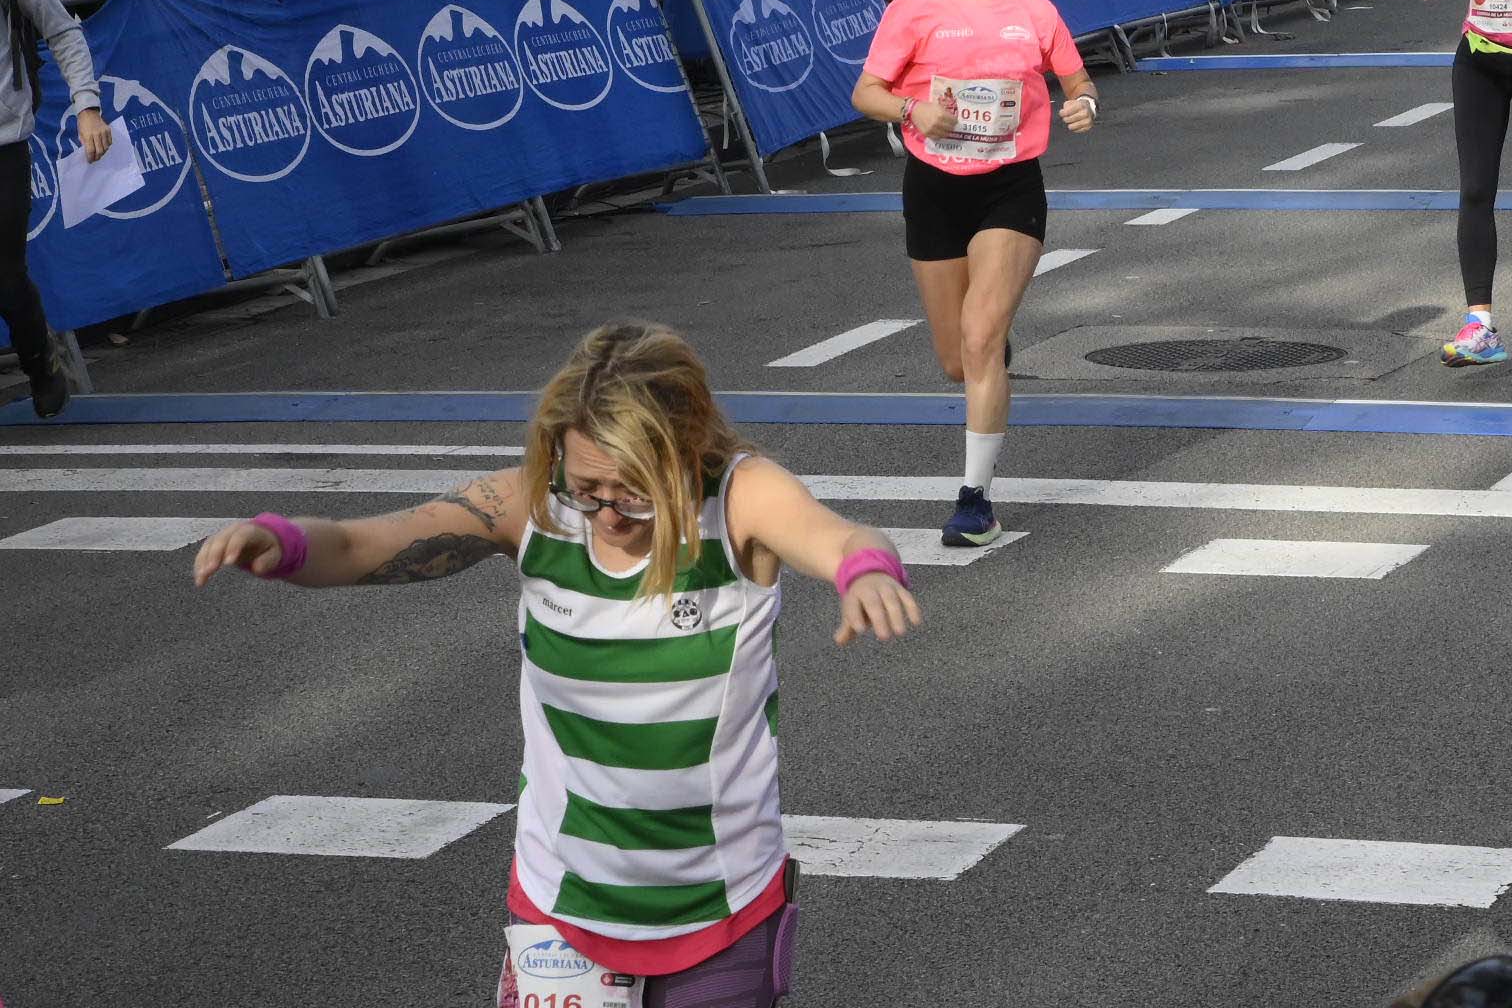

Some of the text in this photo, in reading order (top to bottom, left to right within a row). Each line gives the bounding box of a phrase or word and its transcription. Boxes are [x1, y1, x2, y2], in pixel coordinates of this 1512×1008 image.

[531, 27, 592, 48] CENTRAL LECHERA
[616, 24, 674, 69] ASTUR
[437, 42, 504, 64] CENTRAL LECHERA
[523, 40, 609, 85] ASTURIANA
[326, 62, 401, 86] CENTRAL LECHERA
[428, 55, 520, 104] ASTURIANA
[212, 85, 289, 109] CENTRAL LECHERA
[315, 80, 416, 130] ASTURIANA
[961, 108, 992, 122] 016
[202, 103, 305, 155] ASTURIANA
[962, 123, 987, 133] 31615
[522, 953, 588, 970] ASTURIANA
[523, 992, 583, 1008] 016
